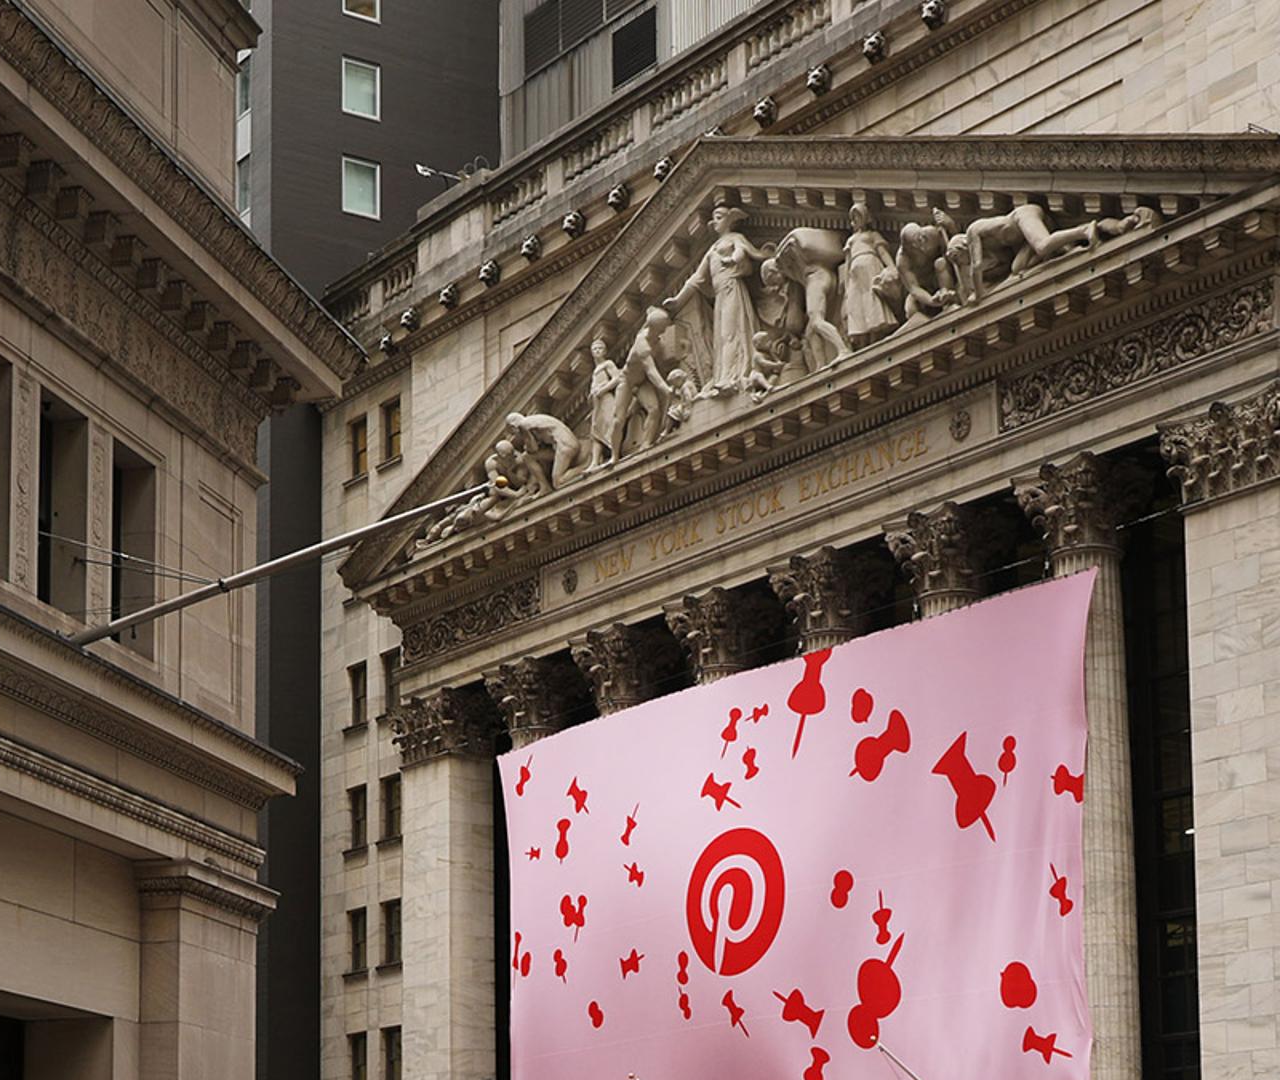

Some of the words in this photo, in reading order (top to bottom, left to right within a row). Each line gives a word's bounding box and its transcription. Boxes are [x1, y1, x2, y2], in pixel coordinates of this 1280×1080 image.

[592, 543, 637, 583] NEW
[647, 516, 704, 561] YORK
[715, 485, 785, 535] STOCK
[798, 427, 929, 503] EXCHANGE
